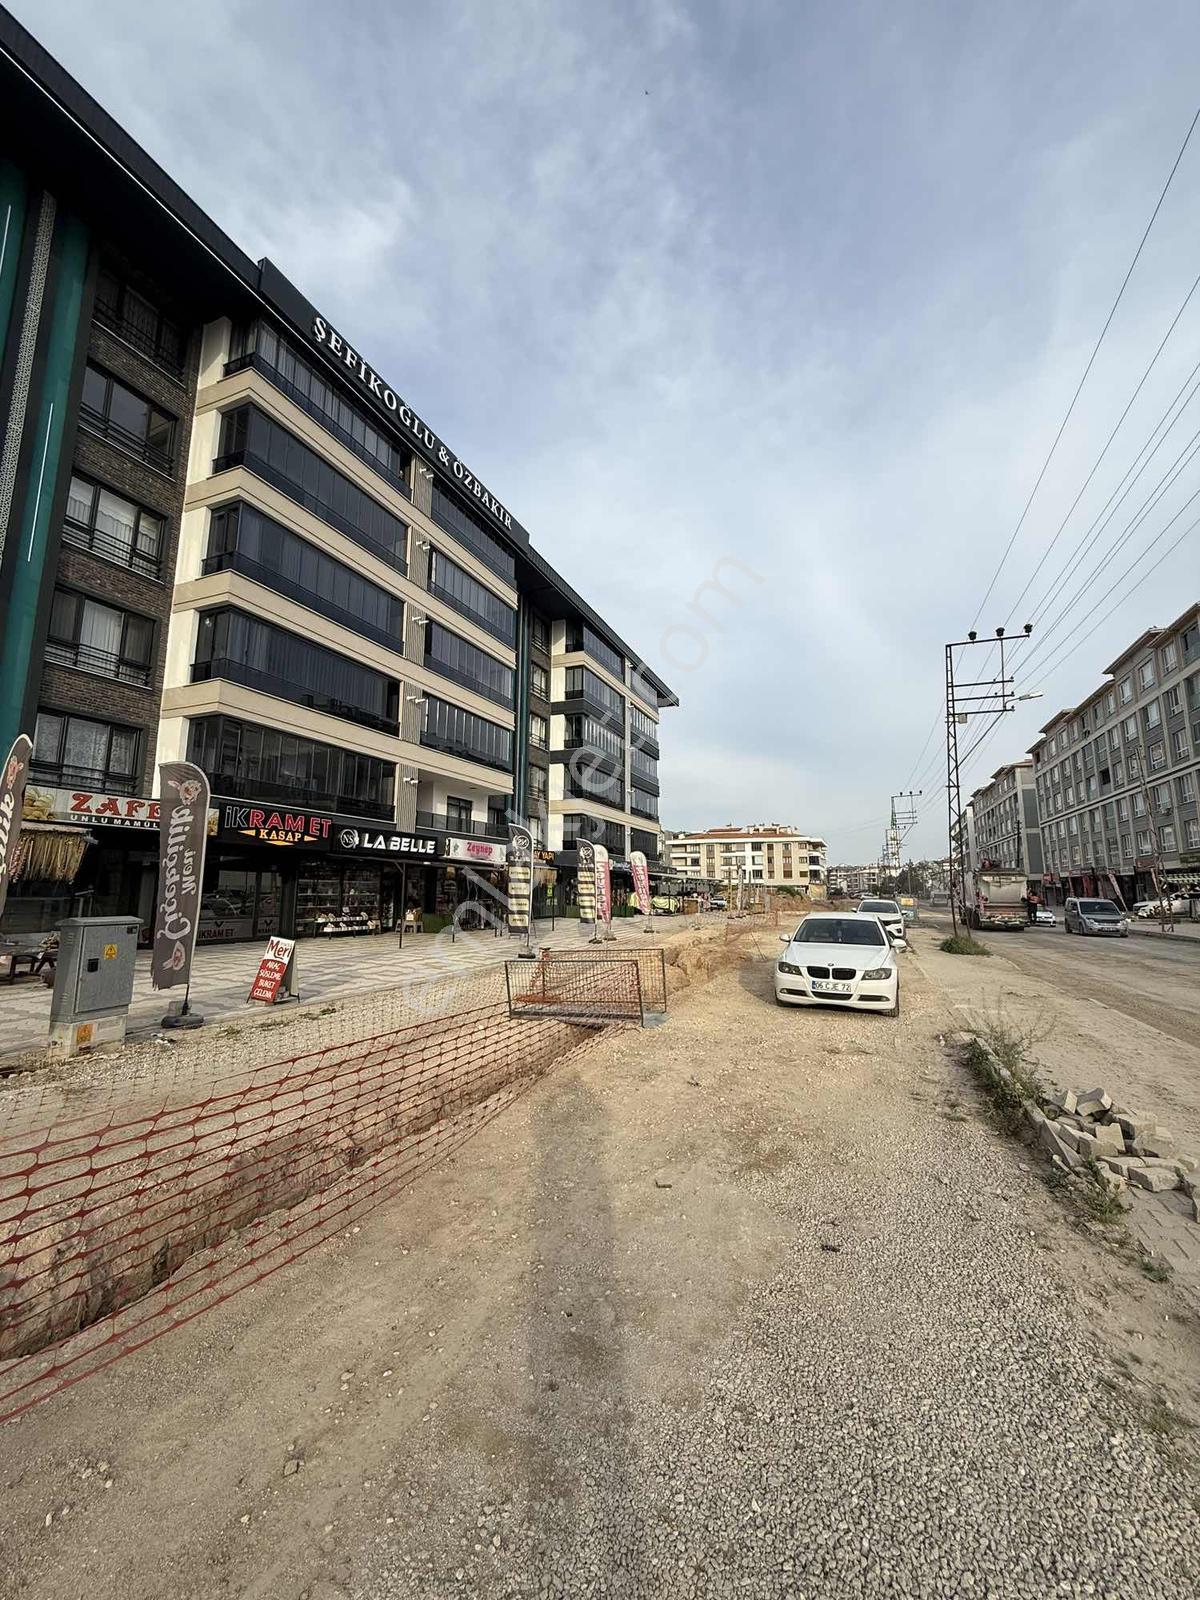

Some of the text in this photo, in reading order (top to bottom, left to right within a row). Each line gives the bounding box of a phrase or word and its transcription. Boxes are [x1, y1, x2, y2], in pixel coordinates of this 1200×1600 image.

[314, 317, 512, 530] ŞEFİKOĞLU & ÖZBAKIR
[70, 814, 108, 824] UNLU
[259, 829, 302, 841] KASAP
[389, 836, 436, 854] BELLE
[466, 841, 493, 857] Zeynep
[266, 939, 293, 960] Meri
